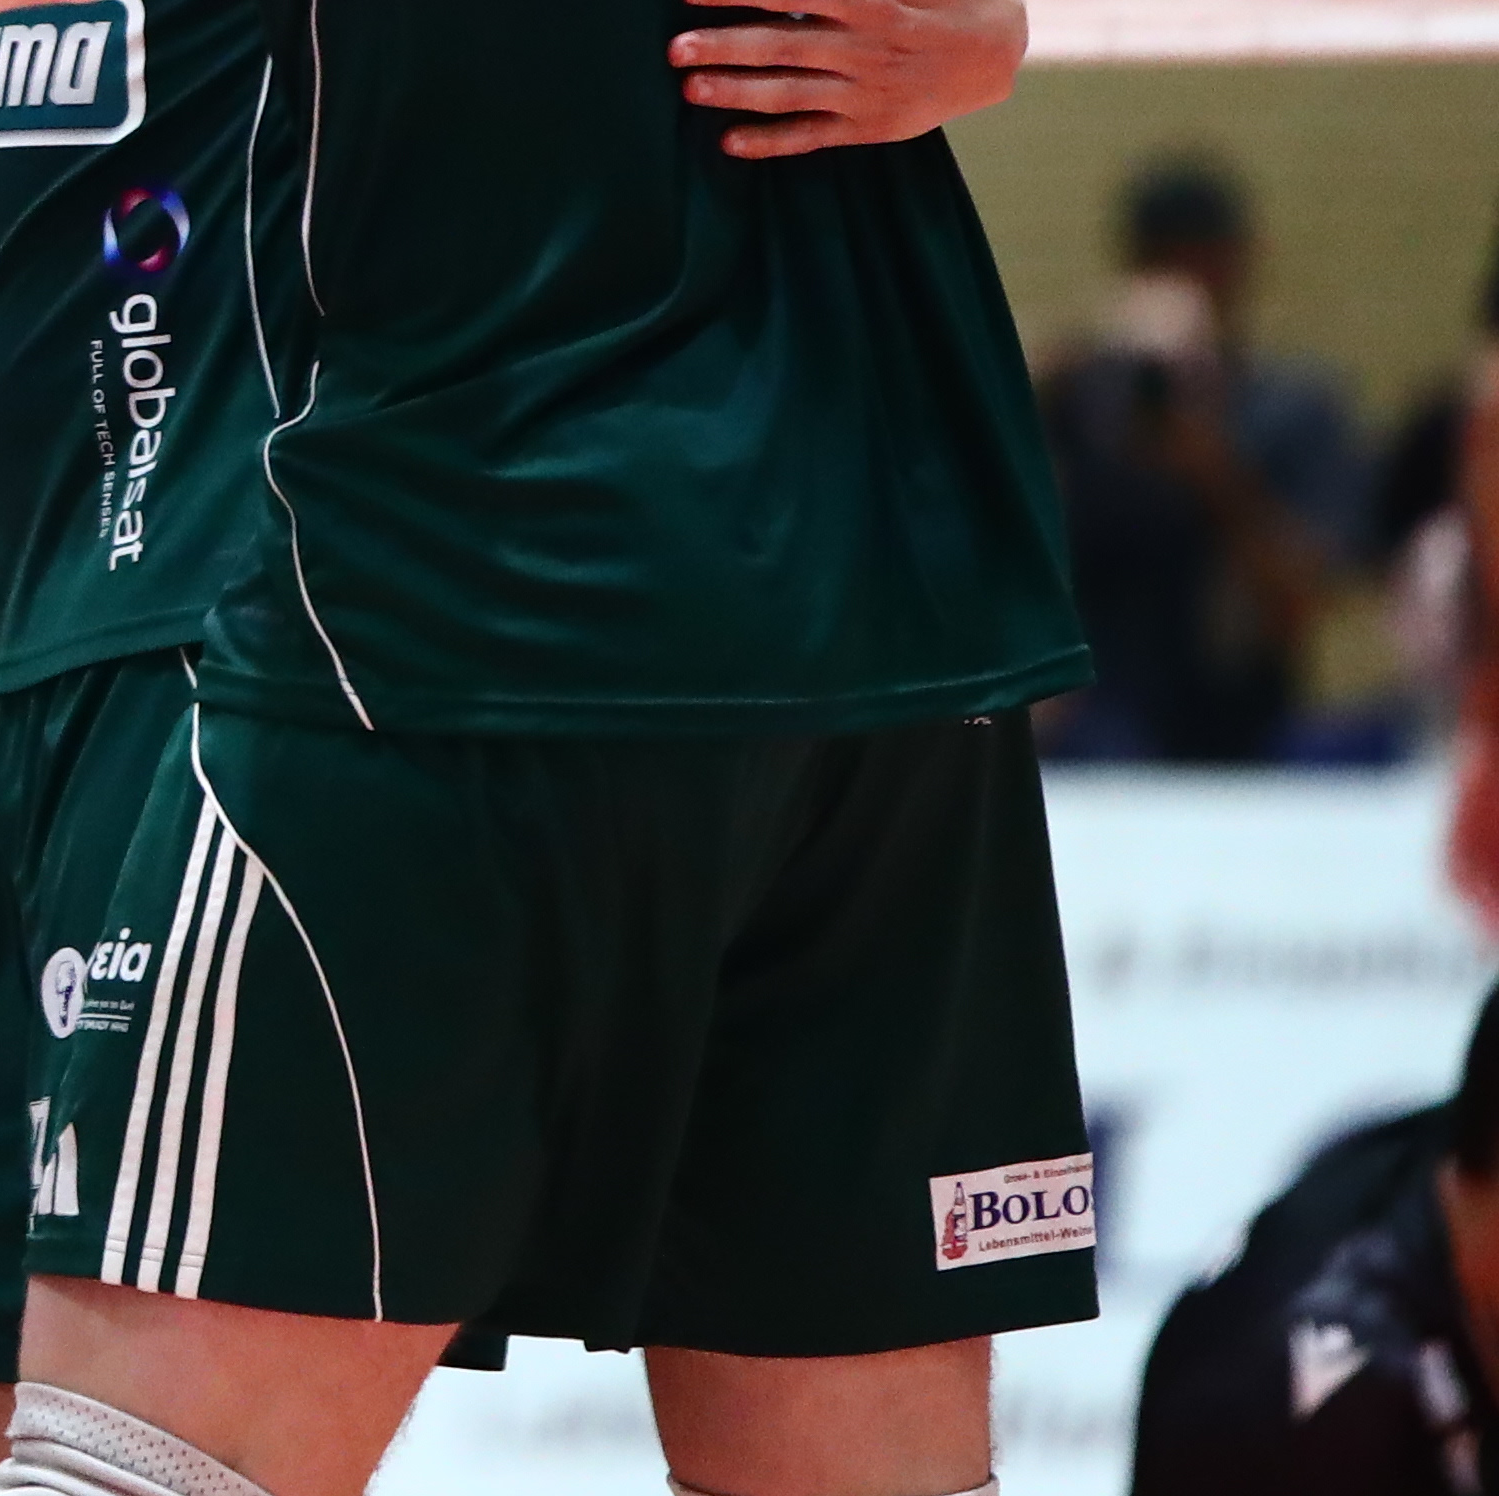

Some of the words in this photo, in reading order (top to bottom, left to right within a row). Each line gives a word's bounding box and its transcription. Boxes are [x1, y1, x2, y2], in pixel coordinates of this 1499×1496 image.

[90, 339, 104, 385] FULL
[92, 388, 106, 415] OF
[94, 419, 116, 467] TECH
[109, 293, 177, 573] globalsat
[968, 1185, 1093, 1232] BOLO
